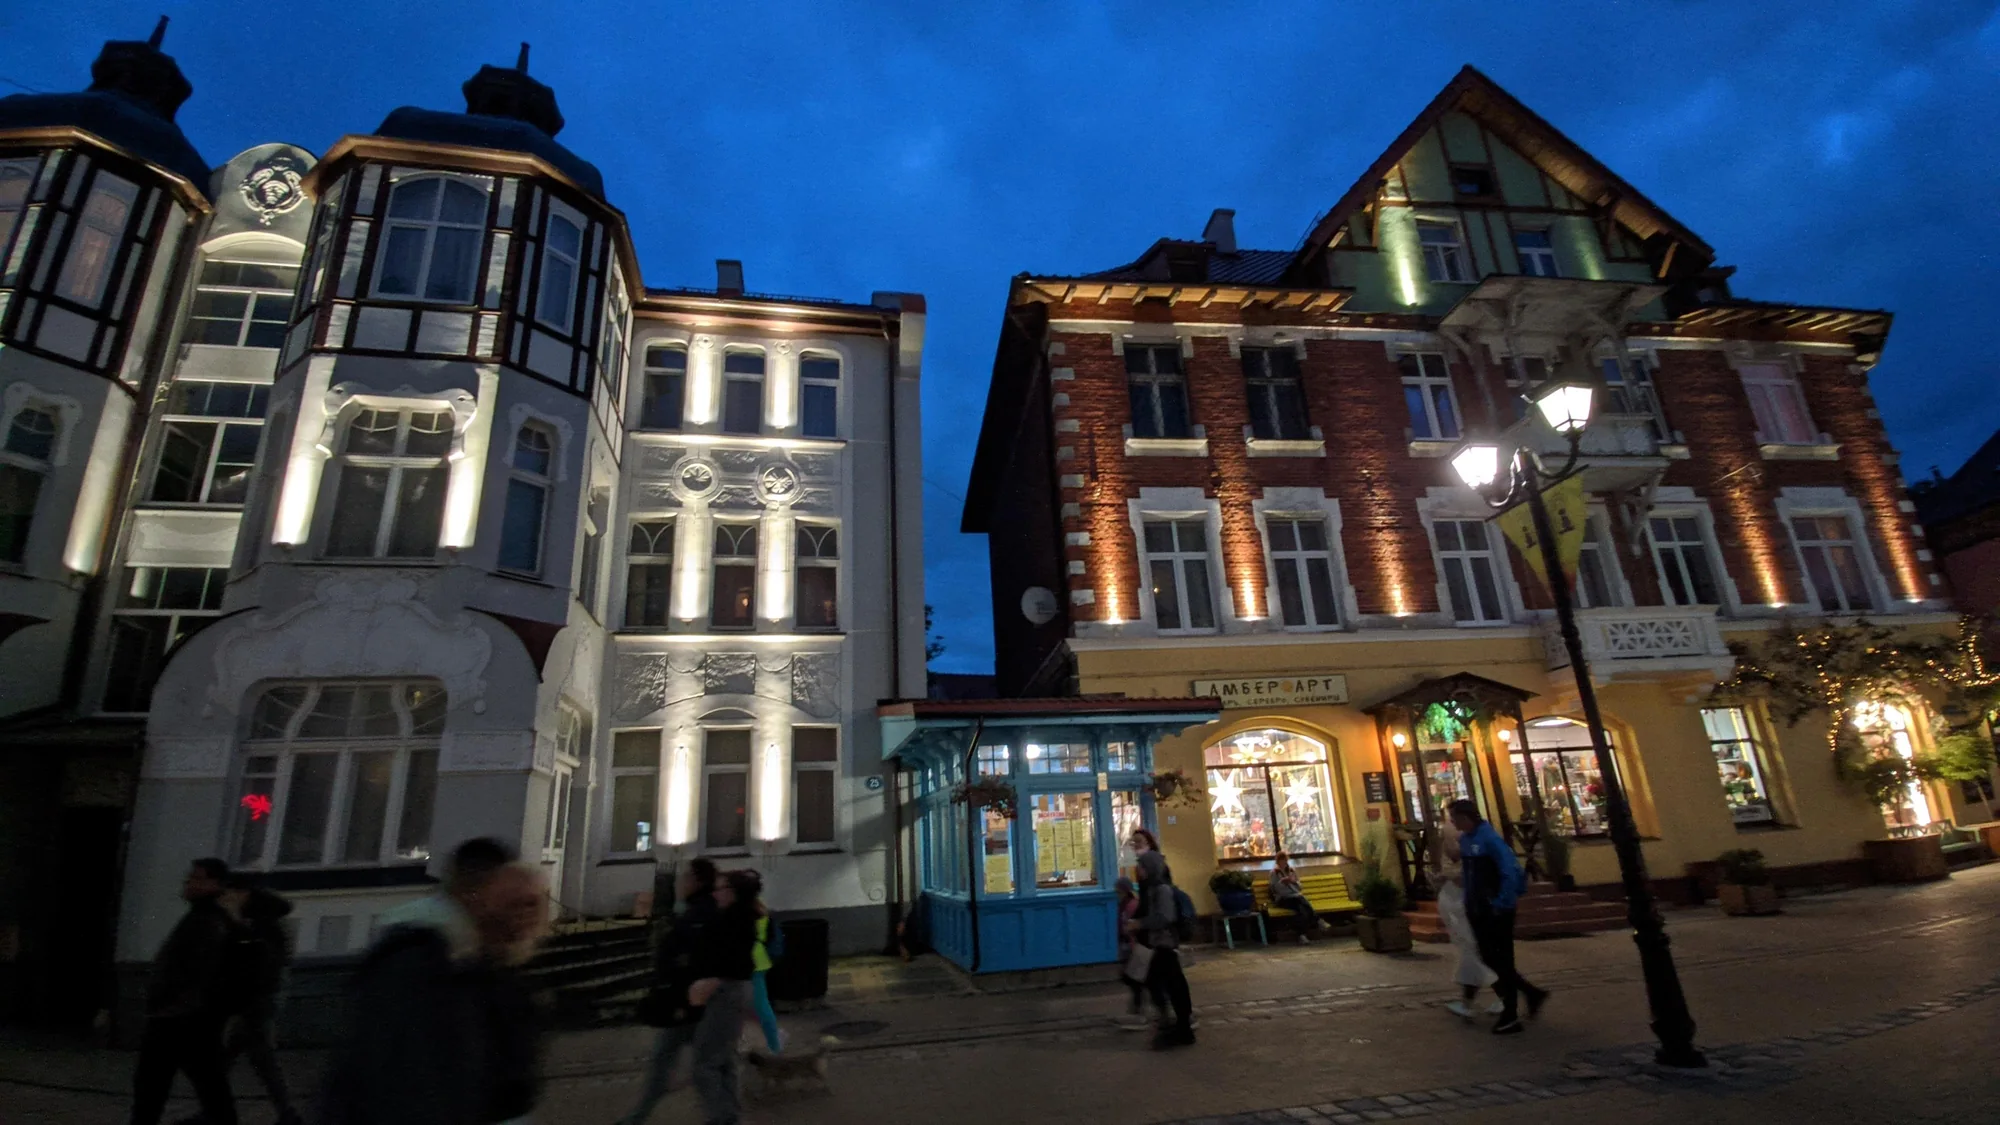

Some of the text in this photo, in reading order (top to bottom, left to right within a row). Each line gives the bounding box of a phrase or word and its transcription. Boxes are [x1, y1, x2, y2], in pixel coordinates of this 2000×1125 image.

[1210, 678, 1332, 696] АМБЕР АРТ
[870, 779, 880, 788] 25
